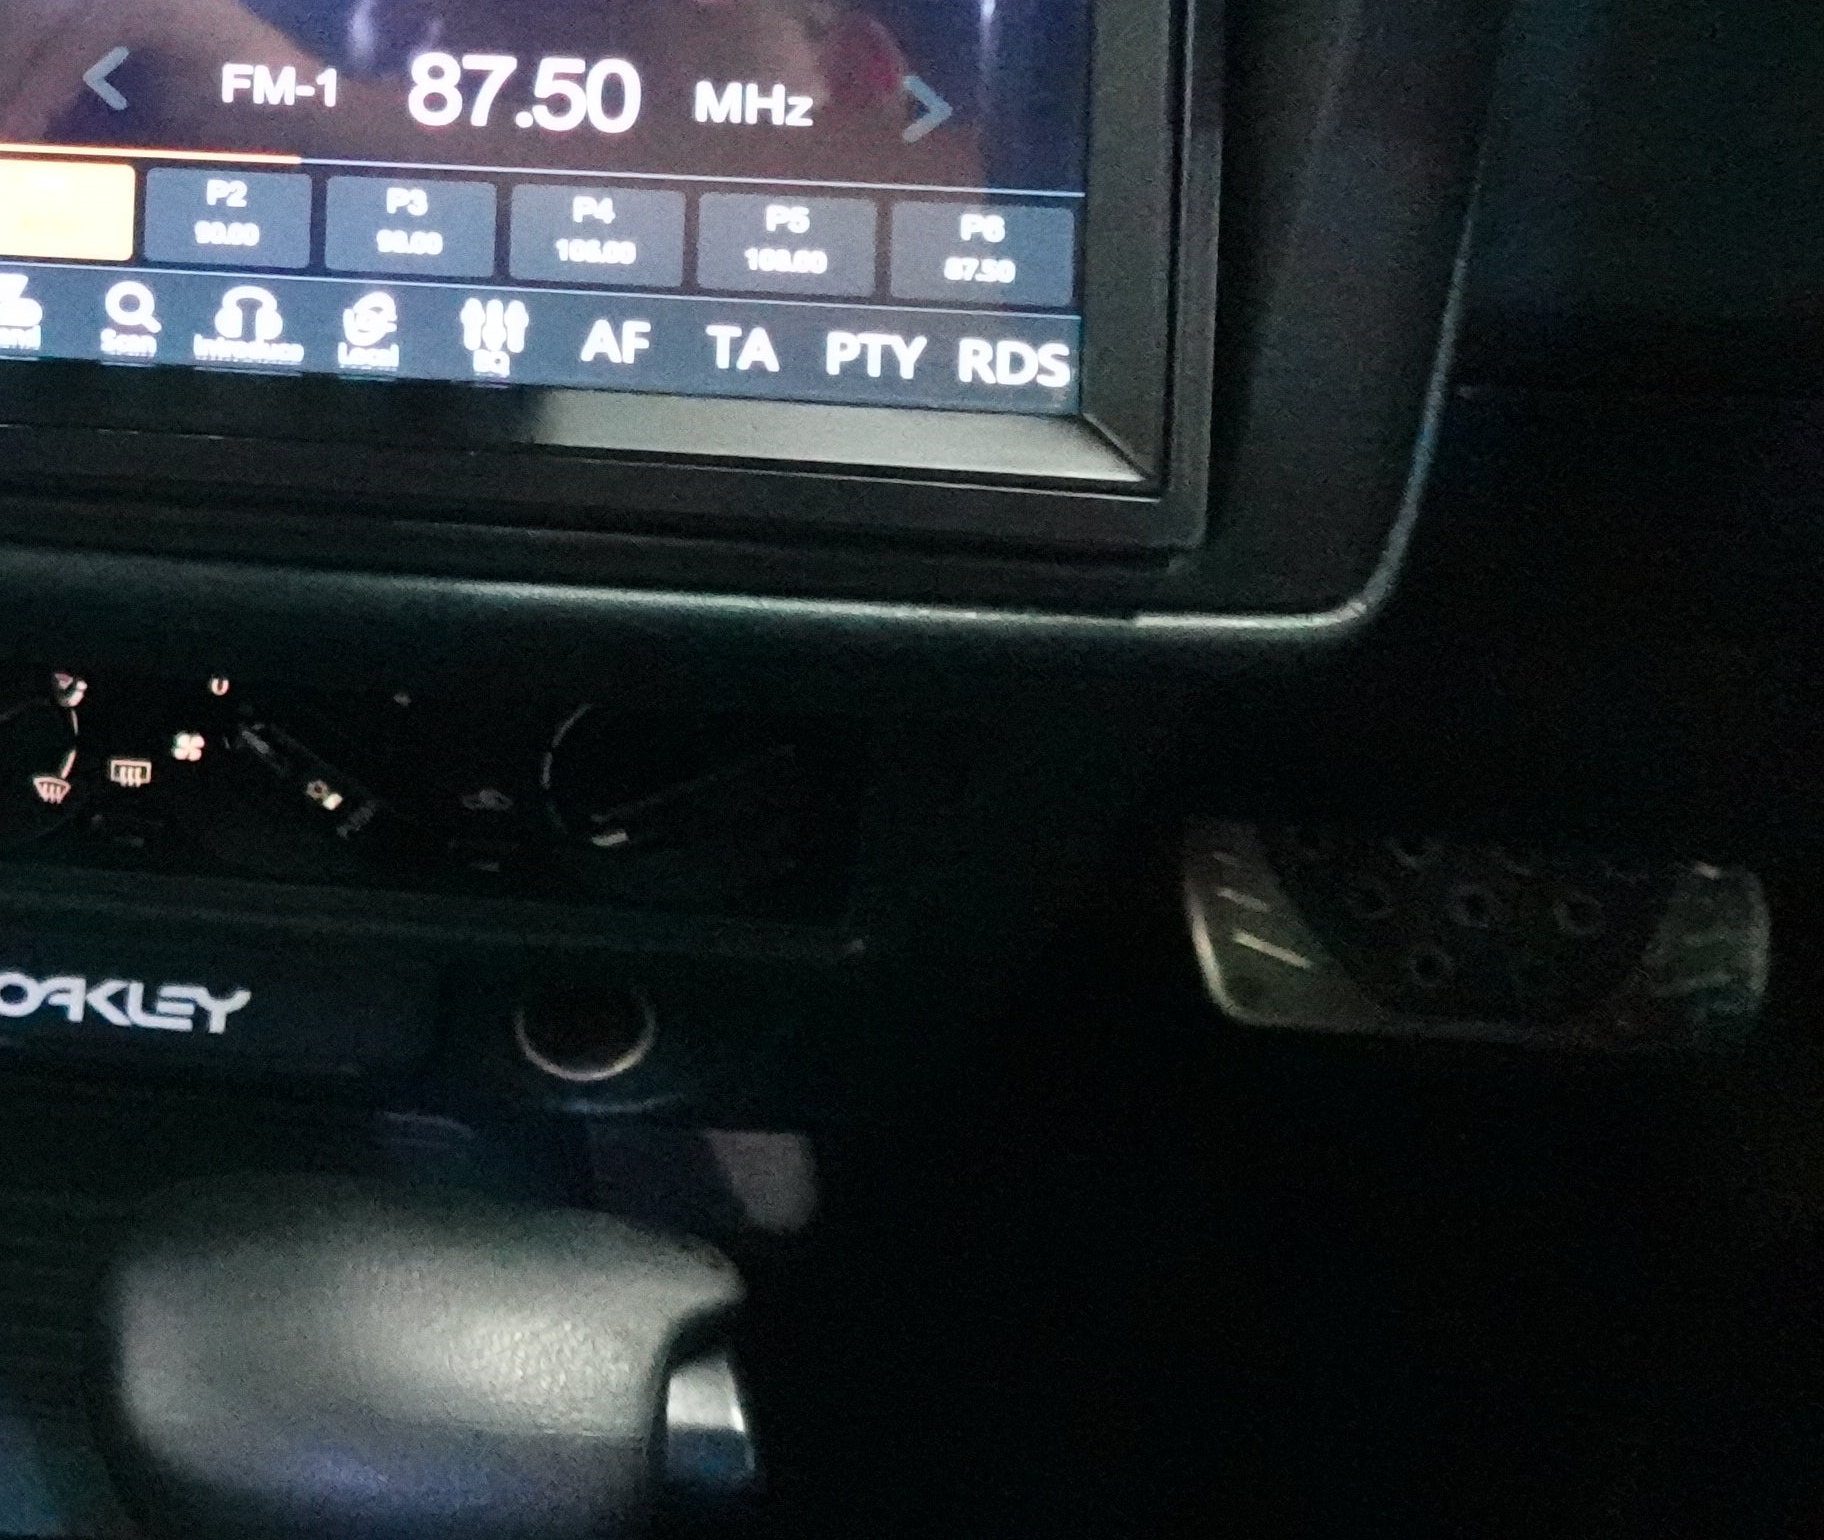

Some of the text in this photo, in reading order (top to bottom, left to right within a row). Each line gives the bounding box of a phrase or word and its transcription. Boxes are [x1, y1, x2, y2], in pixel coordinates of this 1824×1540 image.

[221, 51, 815, 134] FM-1 87.50 MHz
[206, 179, 248, 208] P2
[386, 187, 428, 216] P3
[572, 196, 616, 224] P4
[765, 204, 810, 234] P5
[580, 319, 651, 365] AF
[705, 324, 780, 373] TA
[825, 330, 928, 381] PTY
[956, 338, 1071, 389] RDS
